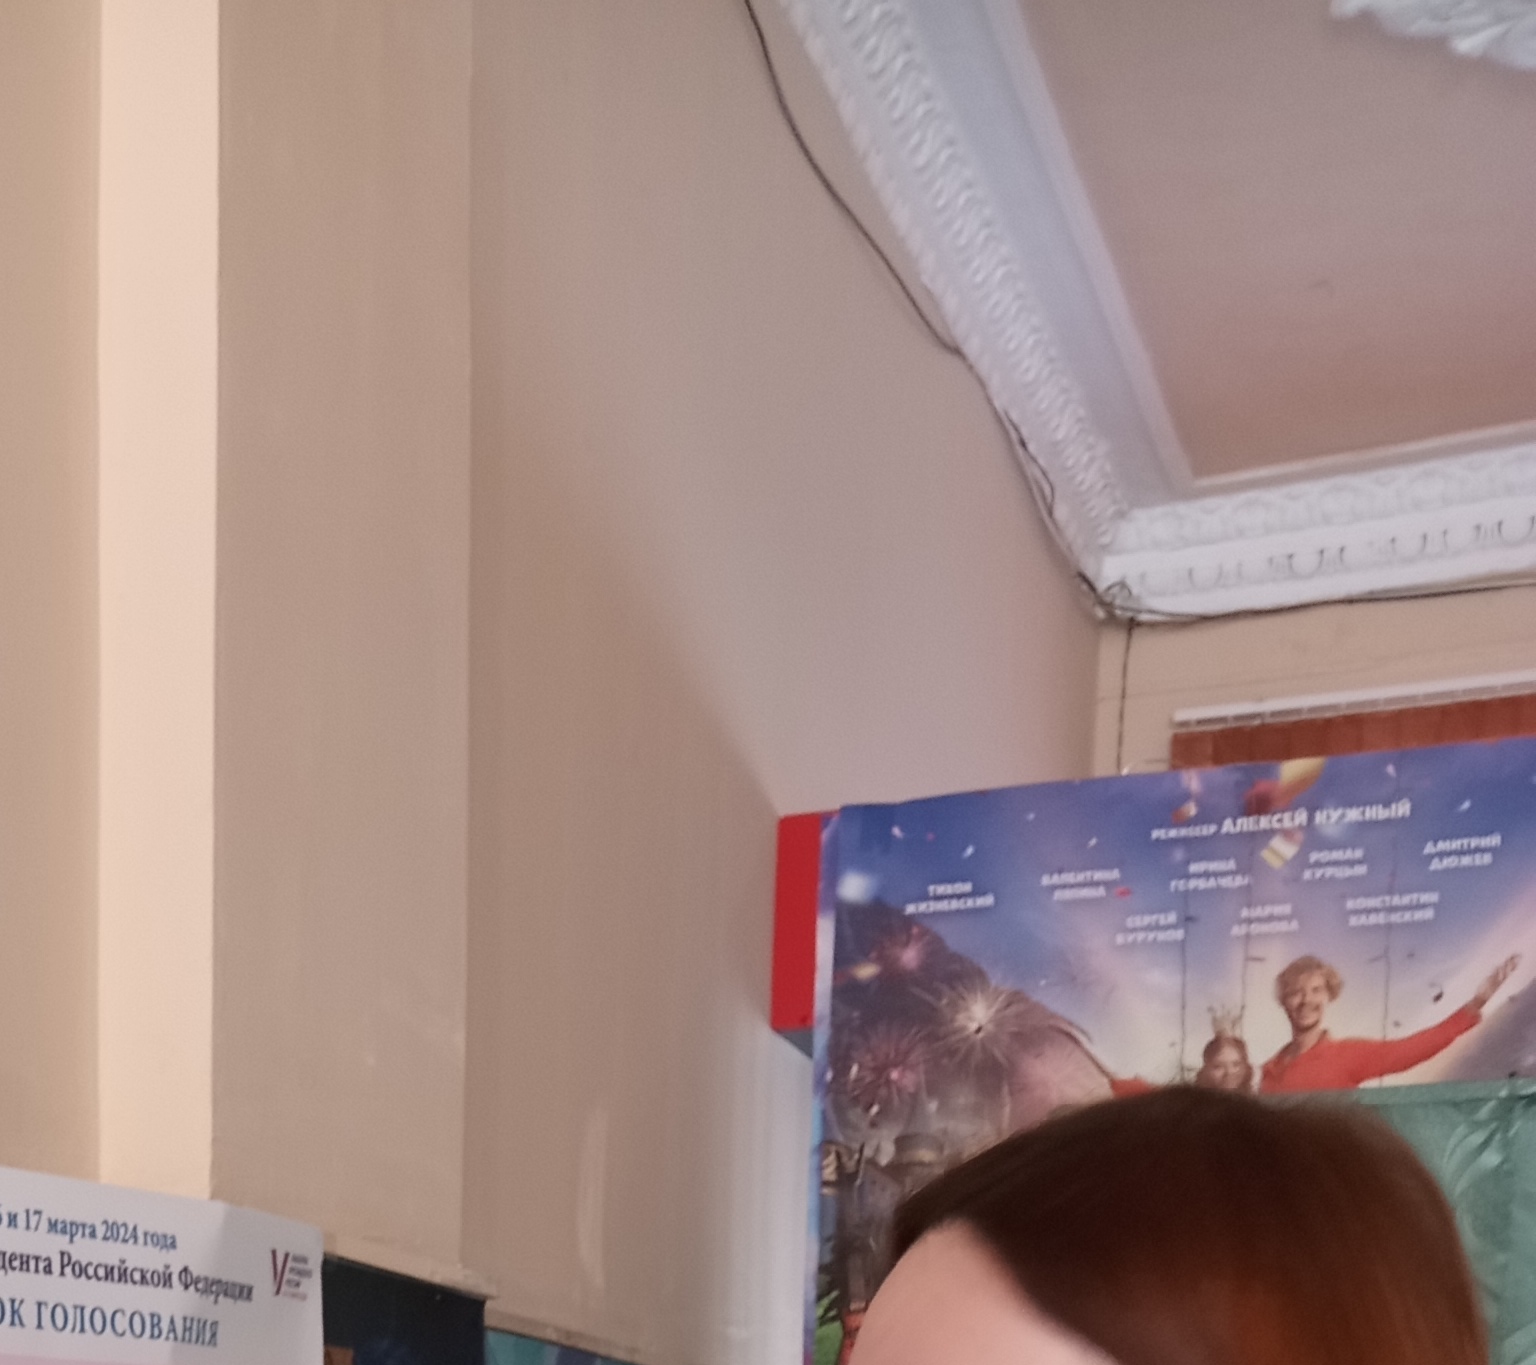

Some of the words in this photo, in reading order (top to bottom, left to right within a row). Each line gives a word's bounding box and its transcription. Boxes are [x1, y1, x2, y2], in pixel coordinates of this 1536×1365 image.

[1220, 807, 1308, 834] АЛЕКСЕЙ
[1314, 798, 1412, 825] НУЖНЫЙ
[6, 1214, 19, 1230] и
[24, 1208, 44, 1232] 17
[47, 1217, 97, 1244] марта
[101, 1219, 139, 1244] 2024
[143, 1230, 178, 1253] года
[59, 1250, 173, 1289] Российской
[178, 1265, 254, 1304] Федерации
[35, 1300, 220, 1348] ГОЛОСОВАНИЯ
